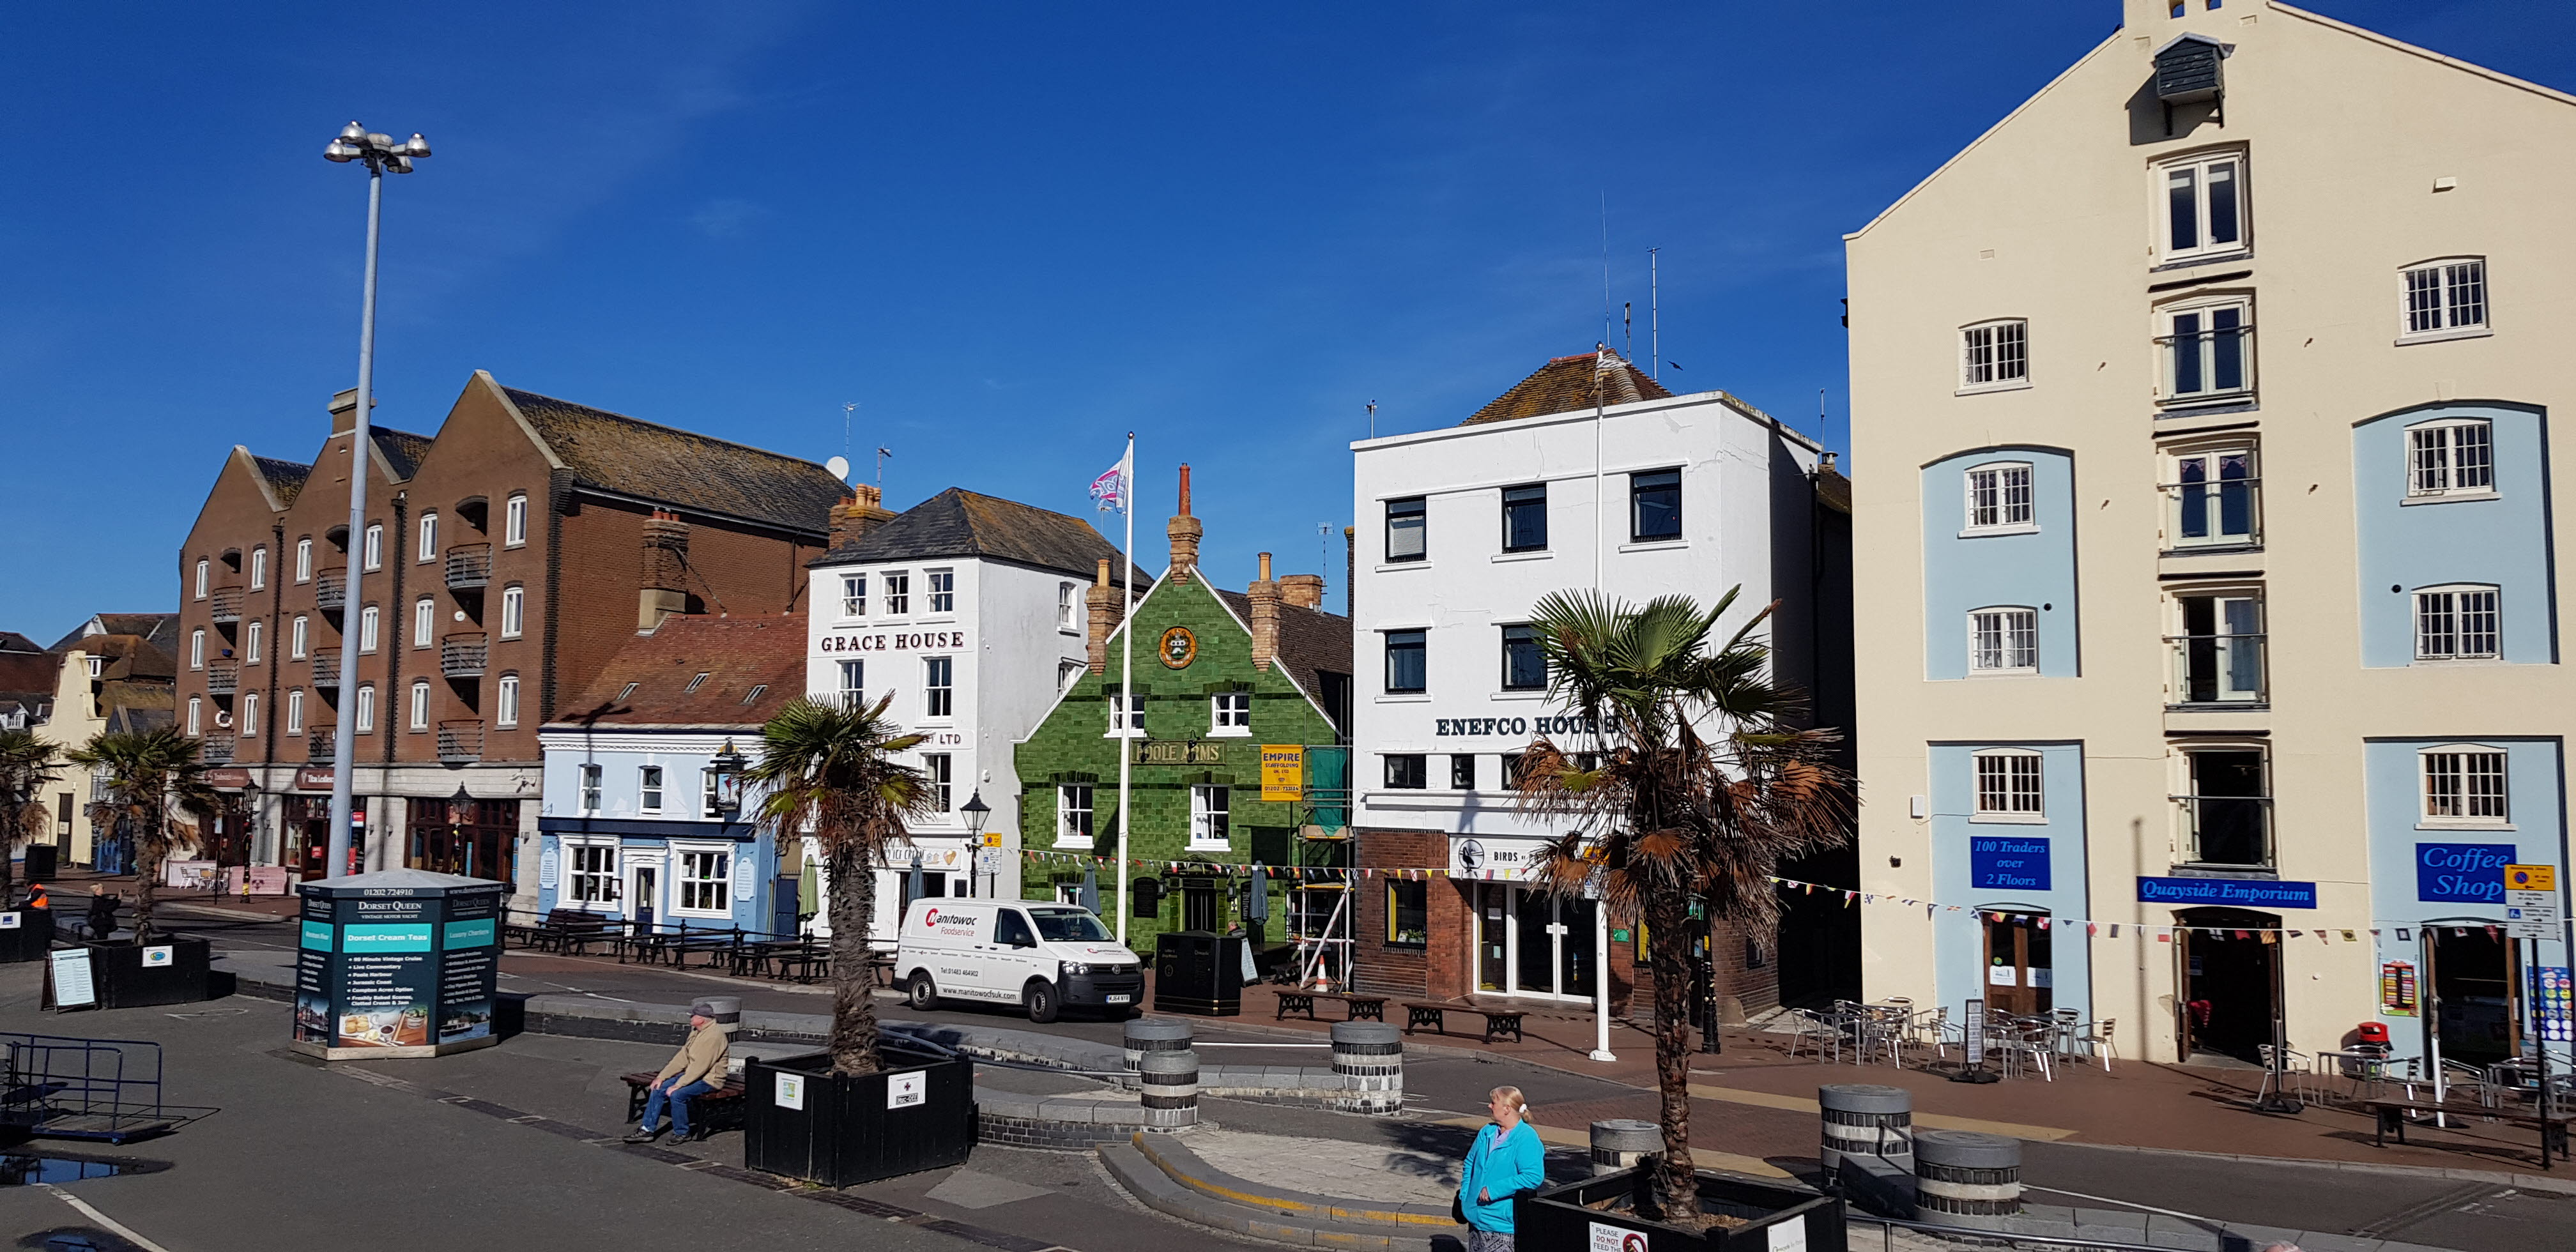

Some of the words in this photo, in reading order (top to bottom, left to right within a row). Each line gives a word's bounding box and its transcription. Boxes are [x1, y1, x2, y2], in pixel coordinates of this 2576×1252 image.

[822, 635, 886, 652] GRACE
[895, 632, 963, 649] HOUSE
[1436, 717, 1526, 736] ENEFCO
[940, 734, 962, 745] LTD
[1136, 745, 1177, 760] POOLE
[1180, 745, 1220, 761] ARMS
[1263, 753, 1300, 761] EMPIRE
[1975, 841, 1997, 851] 100
[2000, 841, 2046, 853] Traders
[905, 850, 924, 860] CREM
[1494, 851, 1518, 862] BIRDS
[2423, 847, 2509, 873] Coffee
[1986, 873, 1994, 885] 2
[1997, 873, 2036, 885] Floors
[2143, 881, 2218, 899] Quayside
[2220, 883, 2310, 902] Emporium
[2432, 874, 2503, 900] Shop
[358, 901, 392, 910] DORSET
[392, 901, 422, 911] QUEEN
[926, 908, 977, 927] Manitowoc
[940, 927, 975, 936] Foodservice
[943, 987, 1016, 1000] www.manitowocfsuk.com
[1595, 1227, 1619, 1238] PLEASE
[1593, 1242, 1609, 1251] FEED
[1606, 1237, 1619, 1246] NOT
